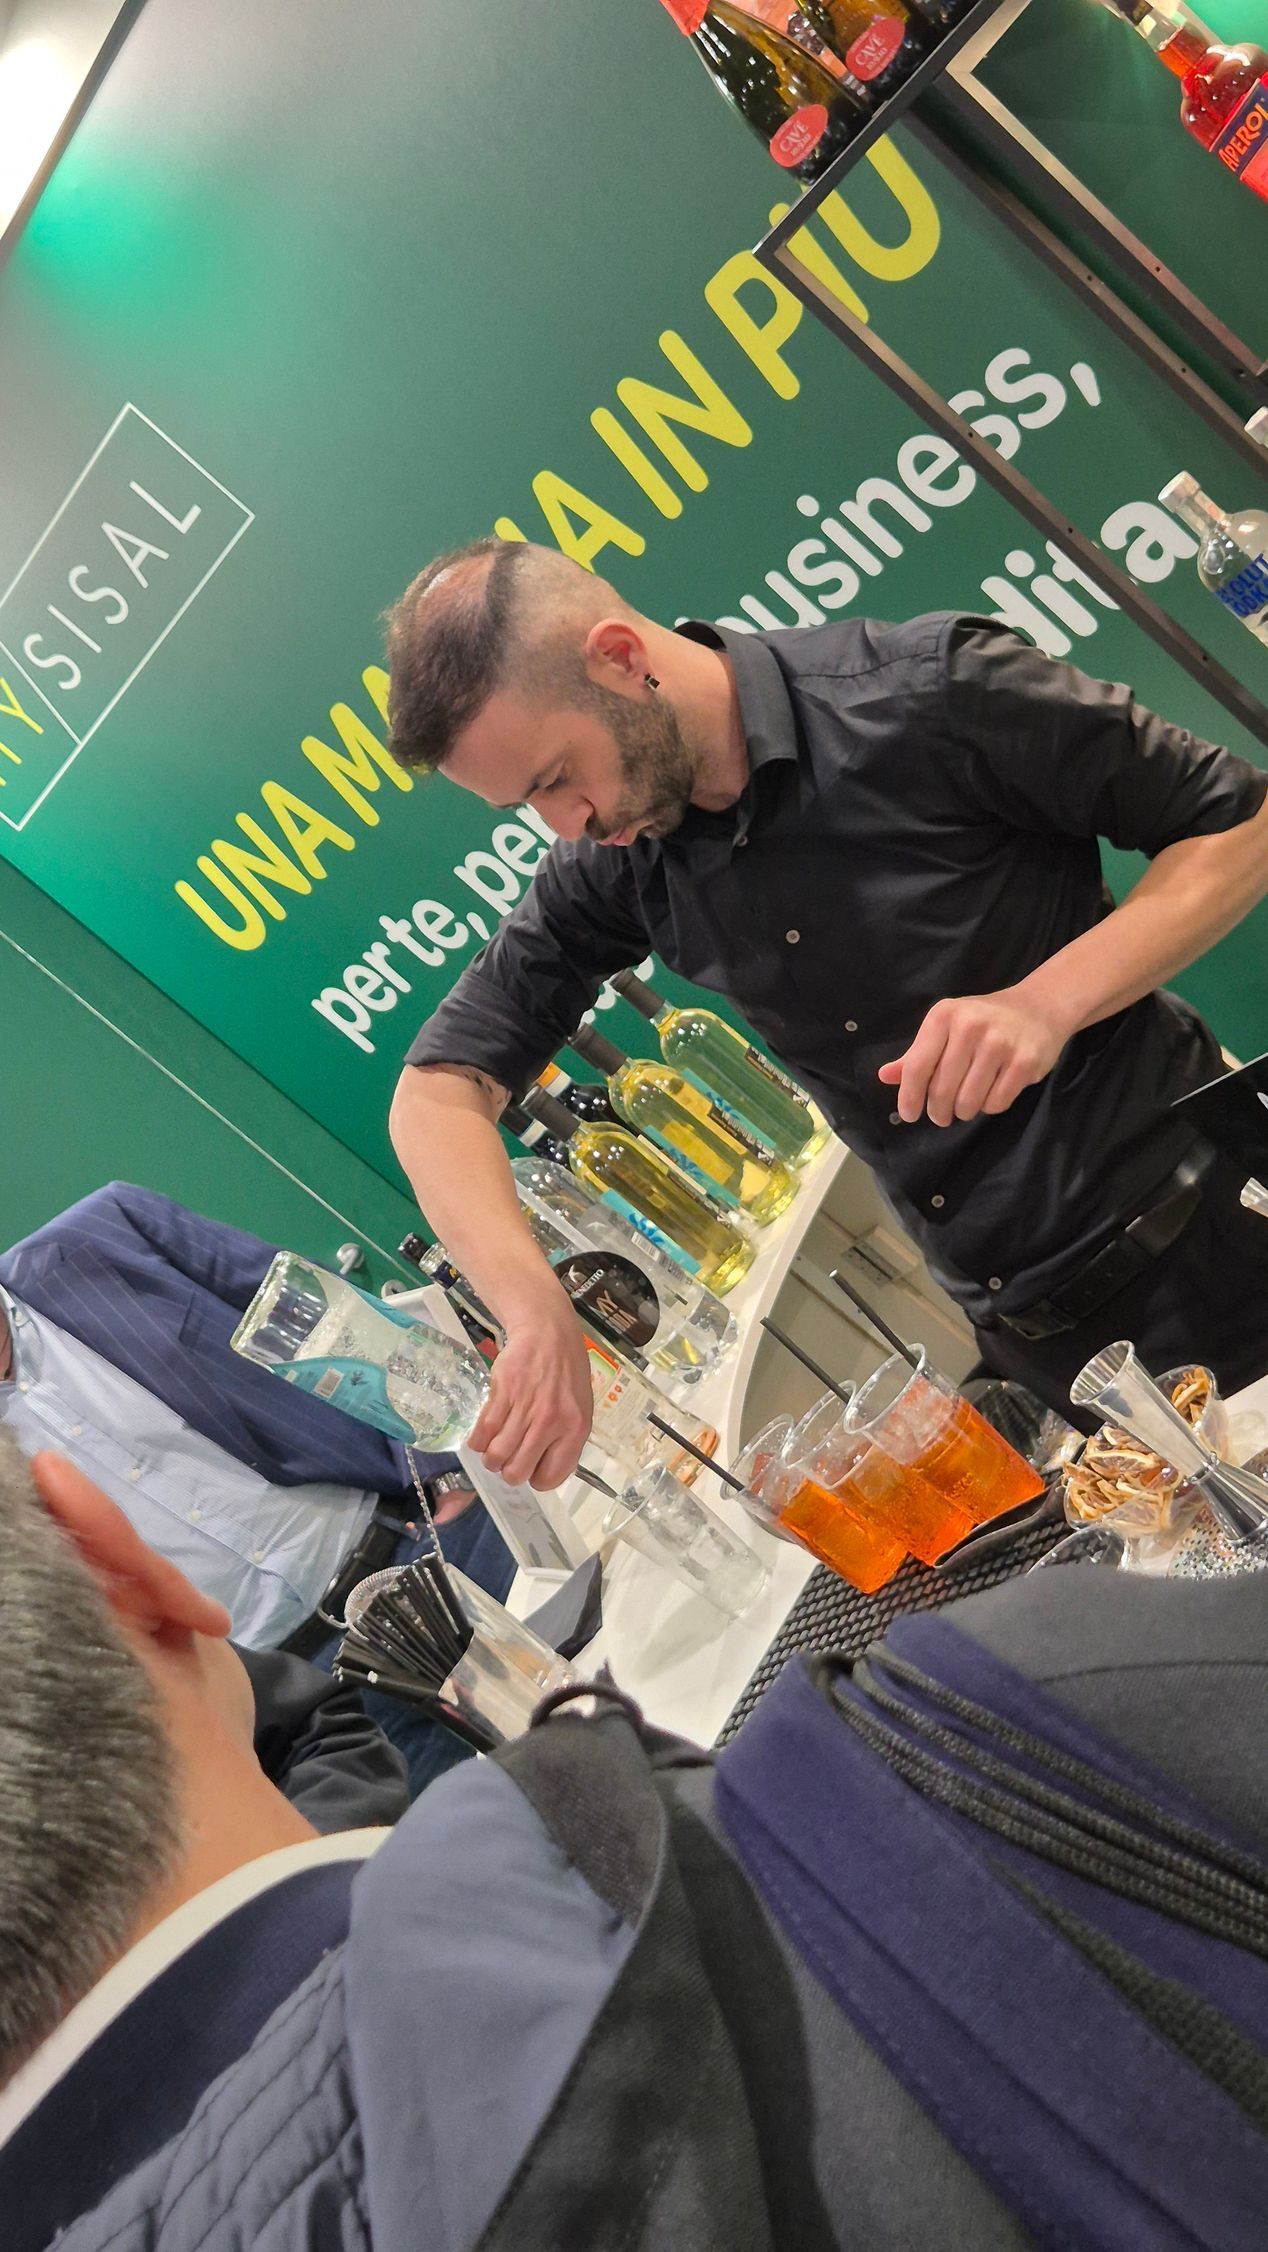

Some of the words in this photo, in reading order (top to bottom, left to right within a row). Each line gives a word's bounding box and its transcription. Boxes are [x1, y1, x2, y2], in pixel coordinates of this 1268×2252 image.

[1218, 103, 1268, 172] APEROL
[23, 480, 202, 691] SISAL
[174, 780, 356, 951] UNA
[590, 329, 753, 520] IN
